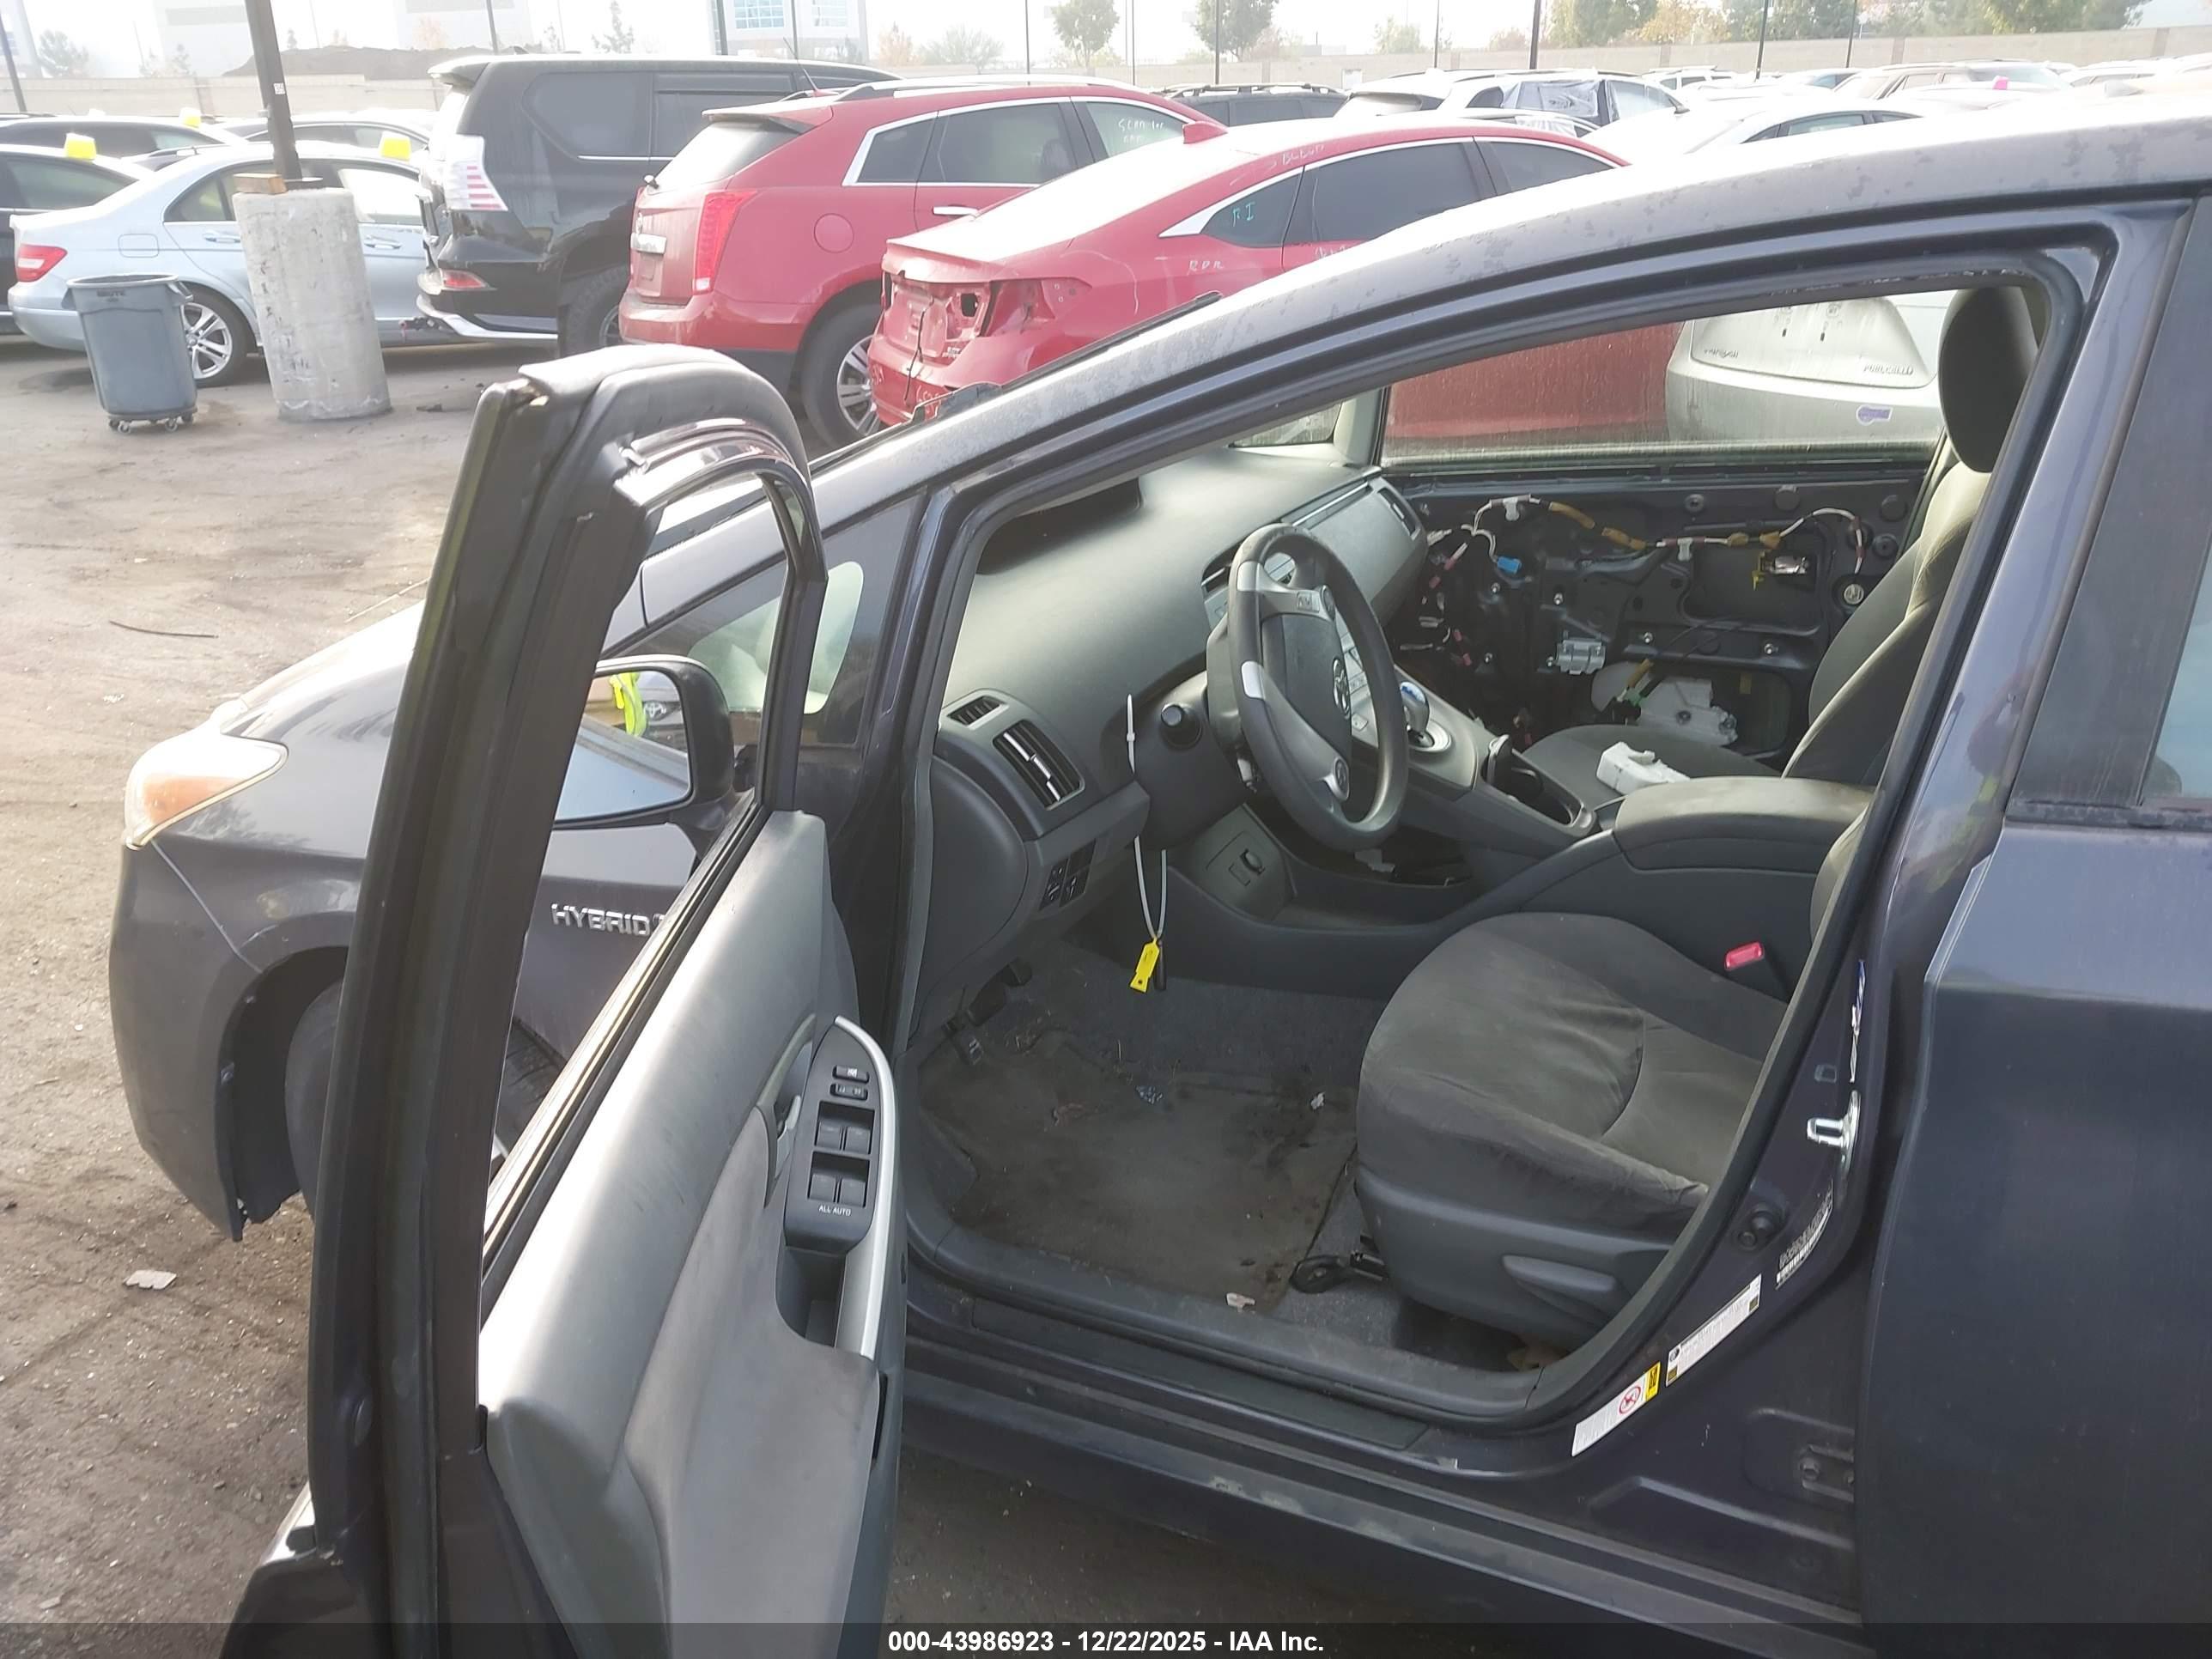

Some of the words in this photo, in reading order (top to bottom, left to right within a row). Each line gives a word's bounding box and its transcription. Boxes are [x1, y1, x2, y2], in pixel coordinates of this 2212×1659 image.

[551, 903, 651, 936] HYBRID
[818, 1205, 831, 1213] ALL
[833, 1206, 851, 1217] AUTO
